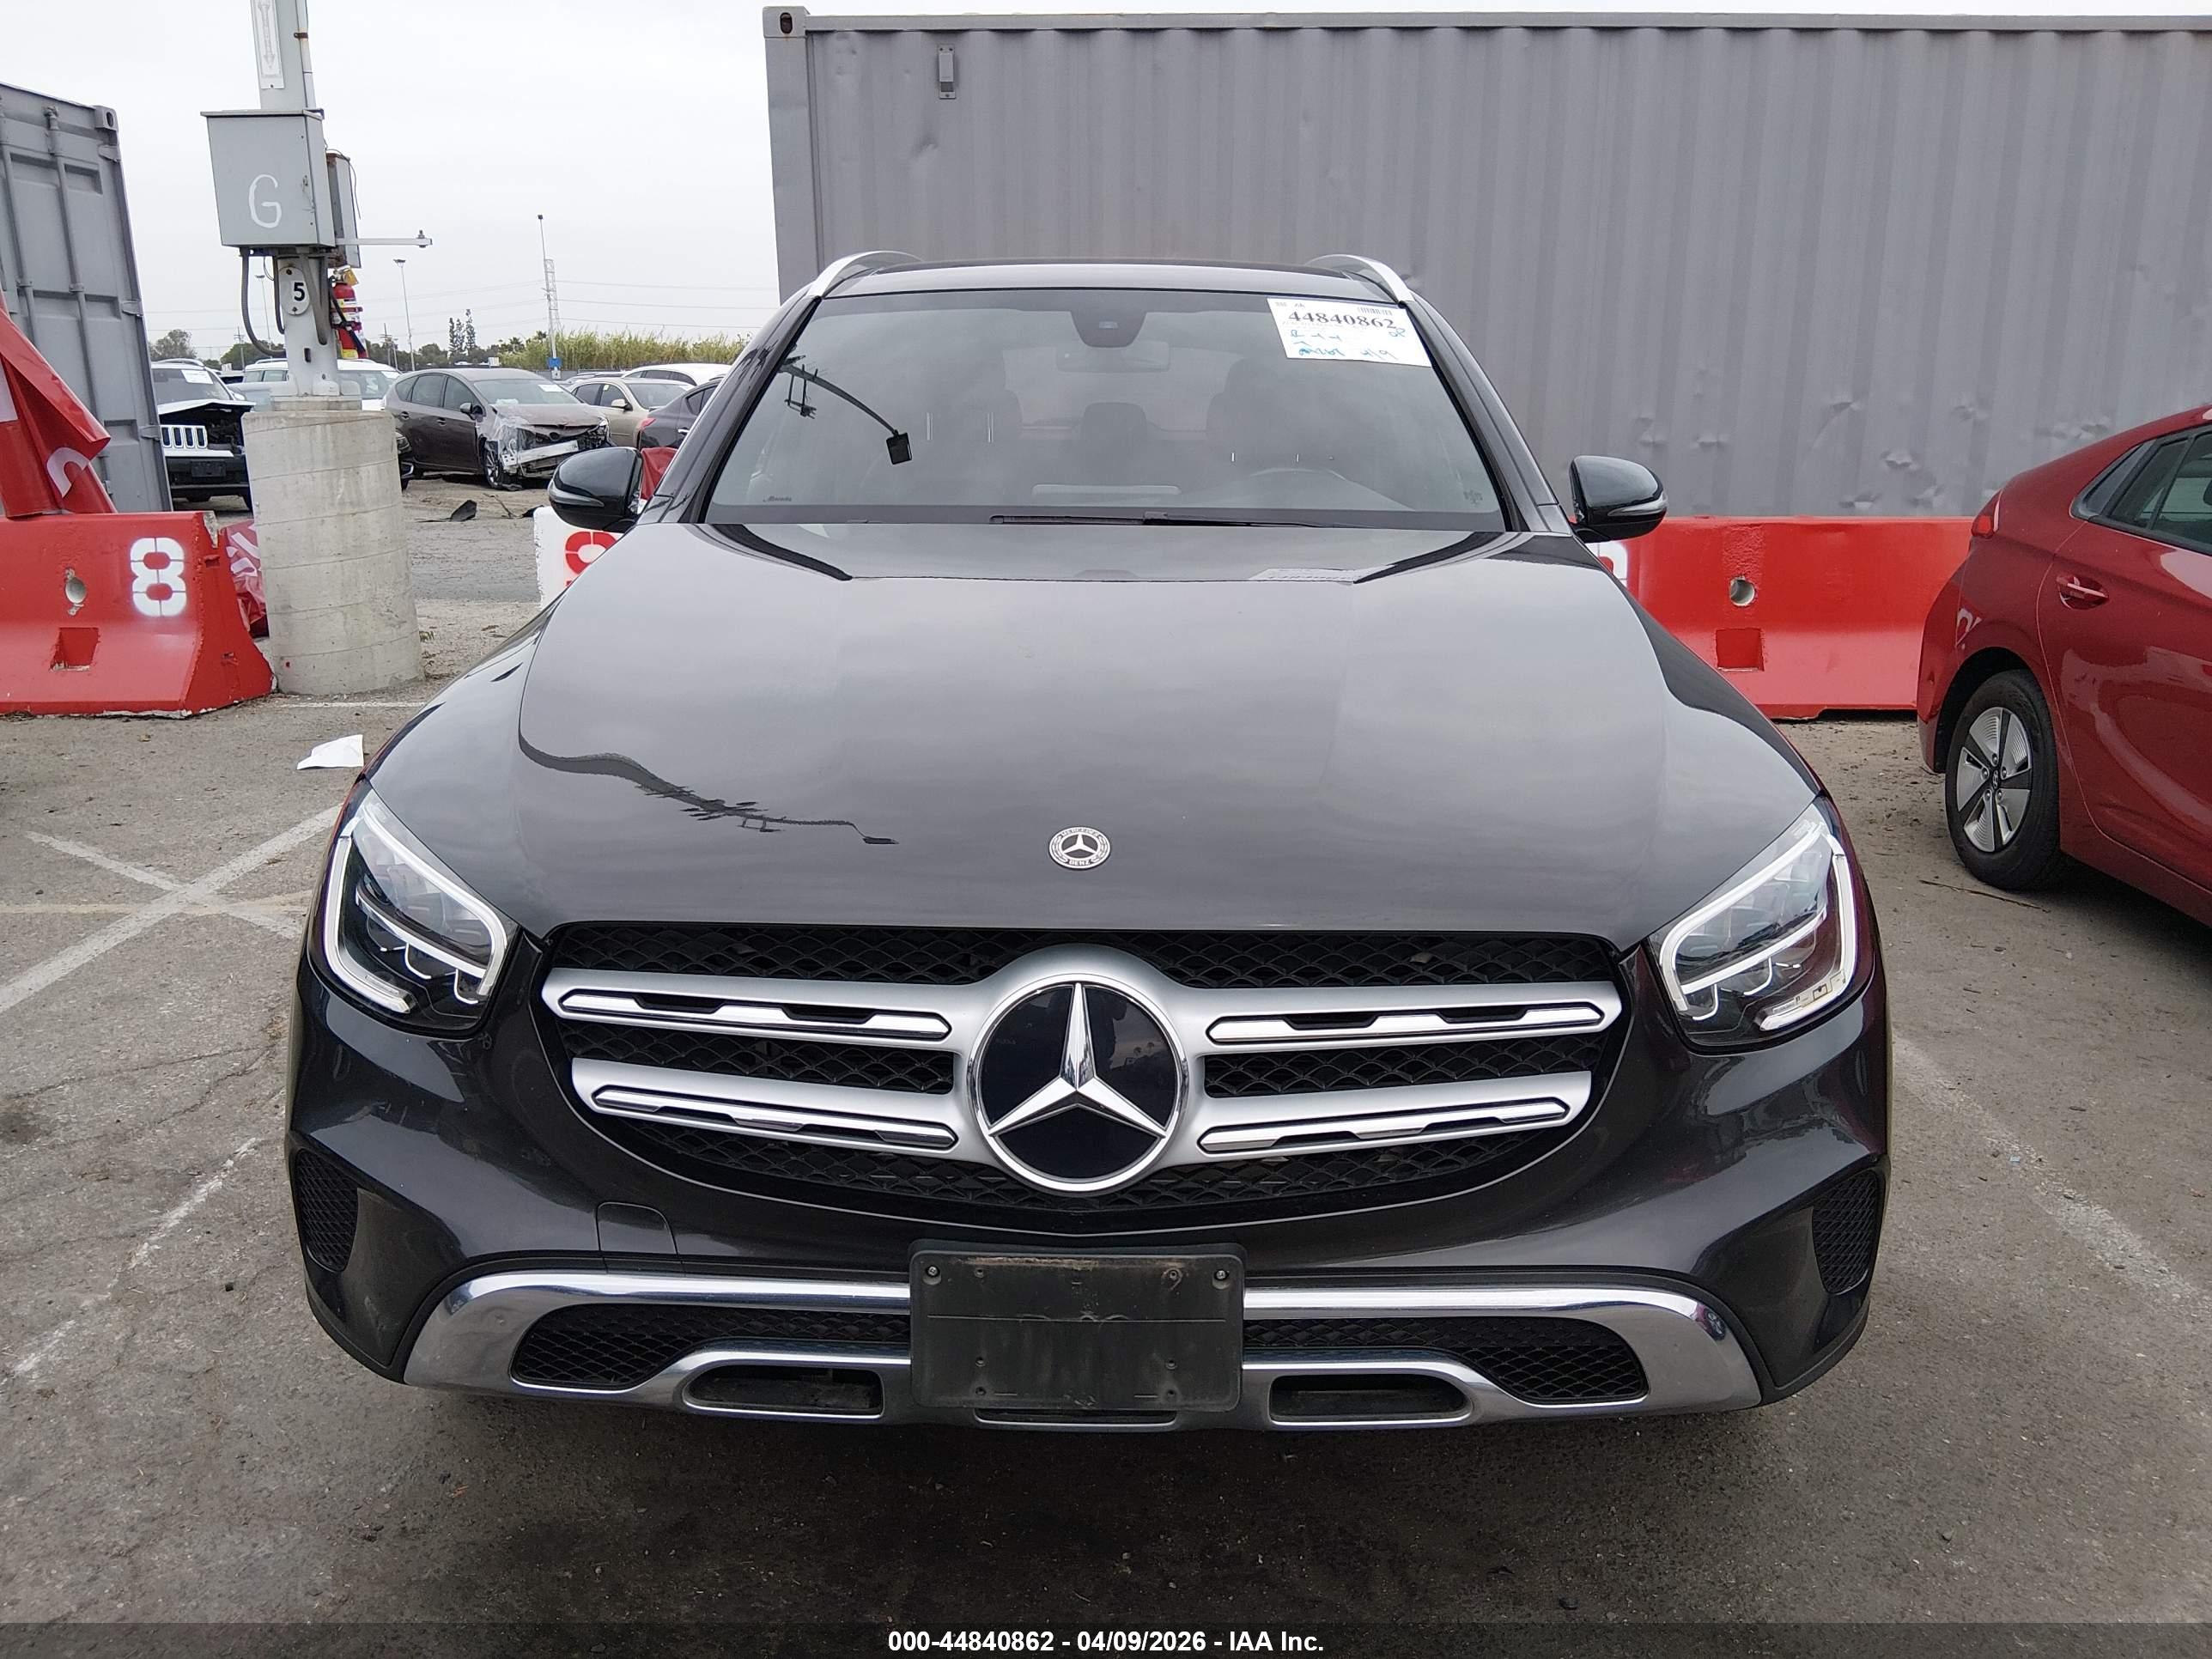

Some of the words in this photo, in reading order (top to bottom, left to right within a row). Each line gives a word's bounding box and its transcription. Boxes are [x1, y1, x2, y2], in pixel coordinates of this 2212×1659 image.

[248, 174, 282, 228] G
[294, 282, 306, 301] 5
[1288, 310, 1397, 330] 44840862
[130, 537, 187, 617] 8
